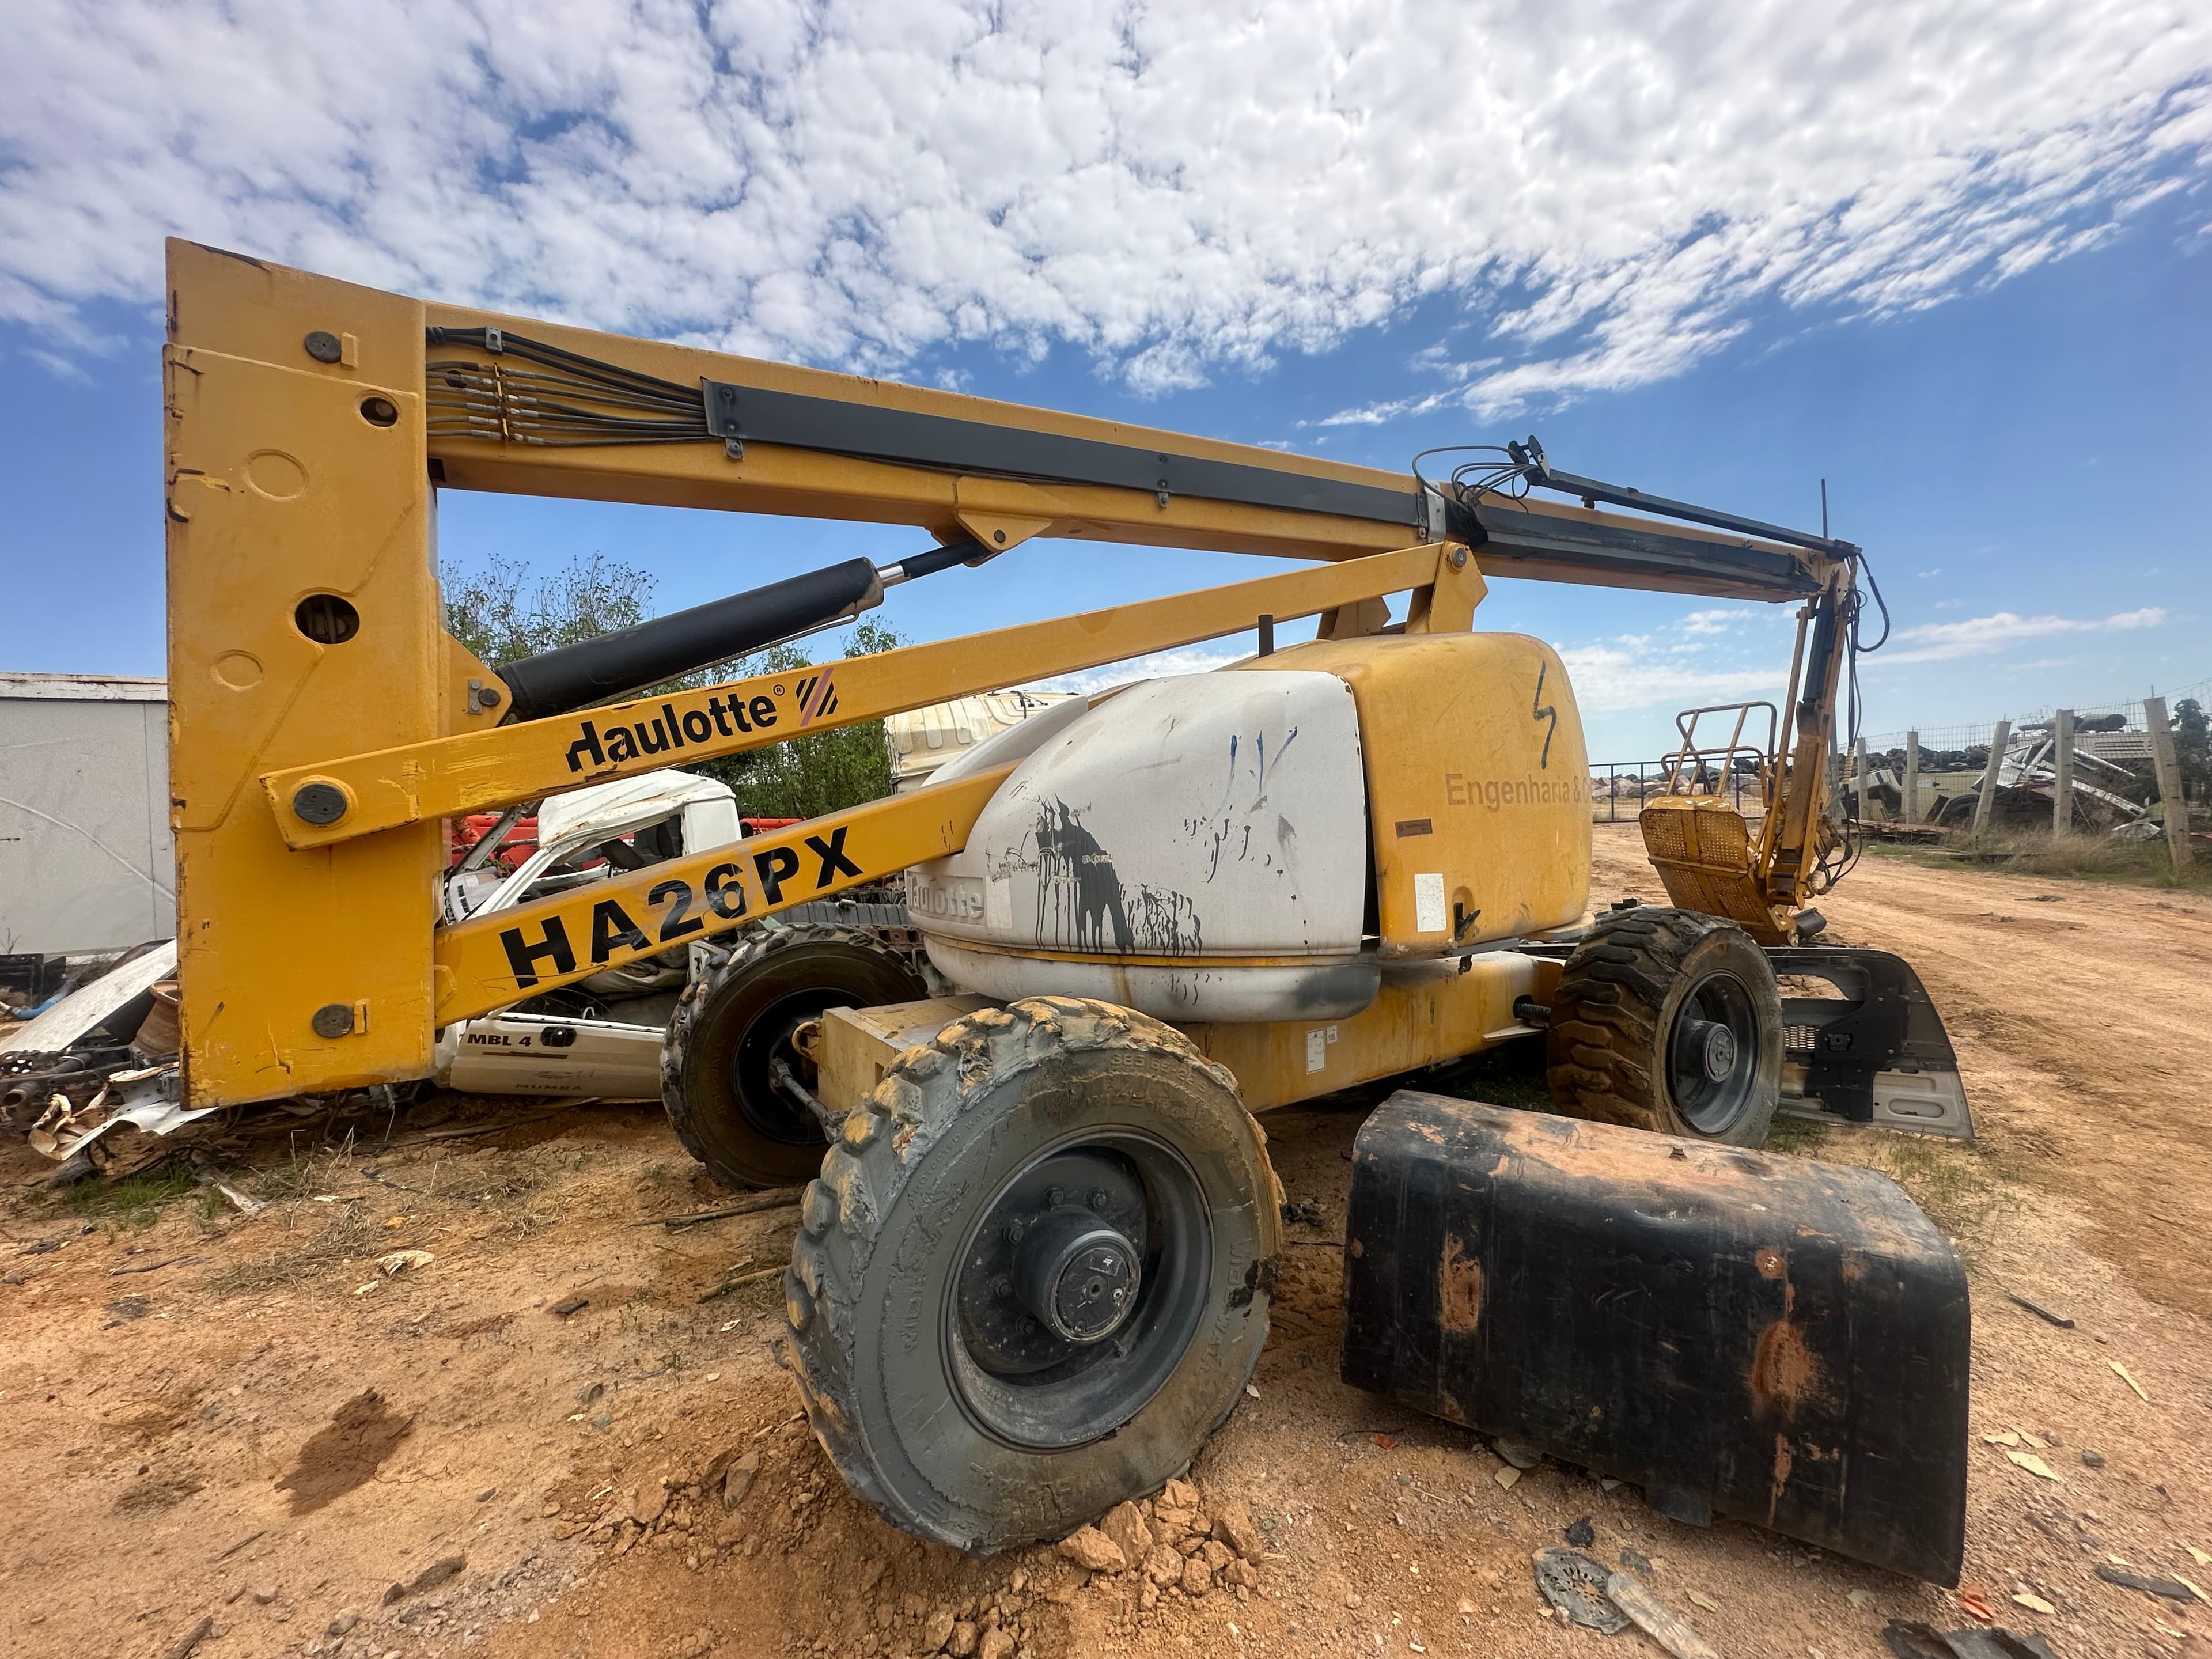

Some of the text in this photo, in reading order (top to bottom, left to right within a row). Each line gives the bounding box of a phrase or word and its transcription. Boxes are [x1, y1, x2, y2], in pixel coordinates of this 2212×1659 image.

[1445, 774, 1570, 812] Engenharia
[500, 825, 863, 989] HA26PX
[907, 875, 984, 918] Haulotte
[467, 1033, 531, 1047] MBL 4
